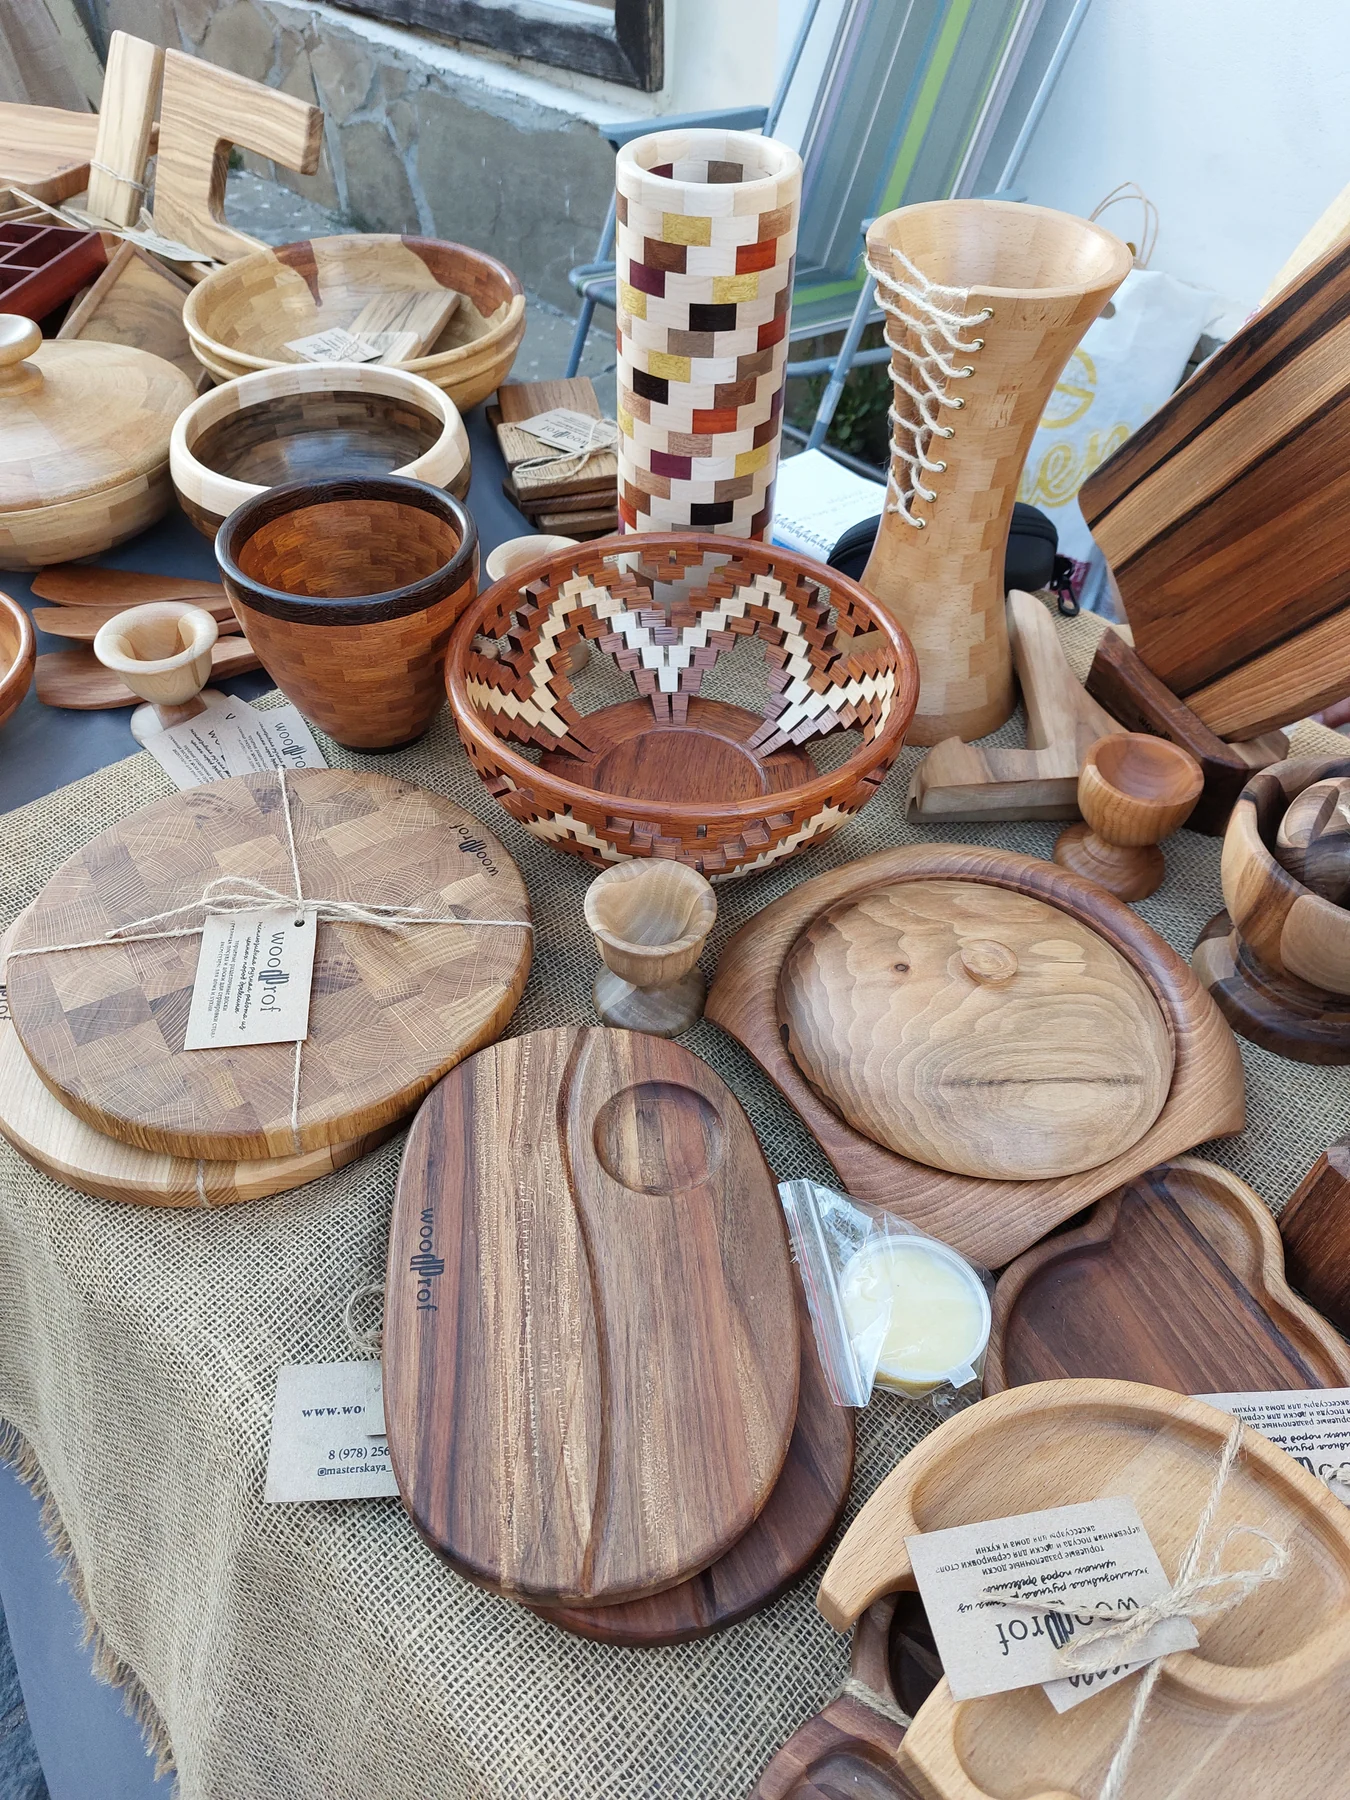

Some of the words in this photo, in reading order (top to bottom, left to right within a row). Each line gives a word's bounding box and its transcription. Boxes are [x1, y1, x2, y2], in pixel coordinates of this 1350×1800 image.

[275, 722, 306, 768] woodpro
[1232, 1405, 1256, 1413] кухни
[1316, 1408, 1344, 1416] посуда
[1262, 1418, 1314, 1429] разделочные
[1316, 1416, 1350, 1425] орцевые
[1290, 1432, 1321, 1442] пород
[328, 1450, 336, 1460] 8
[338, 1447, 368, 1461] (978)
[317, 1463, 393, 1477] @masterskaya_
[1010, 1538, 1030, 1548] дома
[1062, 1536, 1092, 1548] посуда
[975, 1542, 1001, 1555] кухни
[1012, 1549, 1028, 1558] для
[1064, 1544, 1104, 1558] торцевые
[960, 1552, 1012, 1568] сервировки
[1008, 1551, 1064, 1570] разделочные
[982, 1564, 1008, 1576] доски
[1074, 1559, 1116, 1574] ценных
[1040, 1570, 1072, 1584] пород
[1022, 1582, 1067, 1600] ручная
[957, 1603, 973, 1614] из
